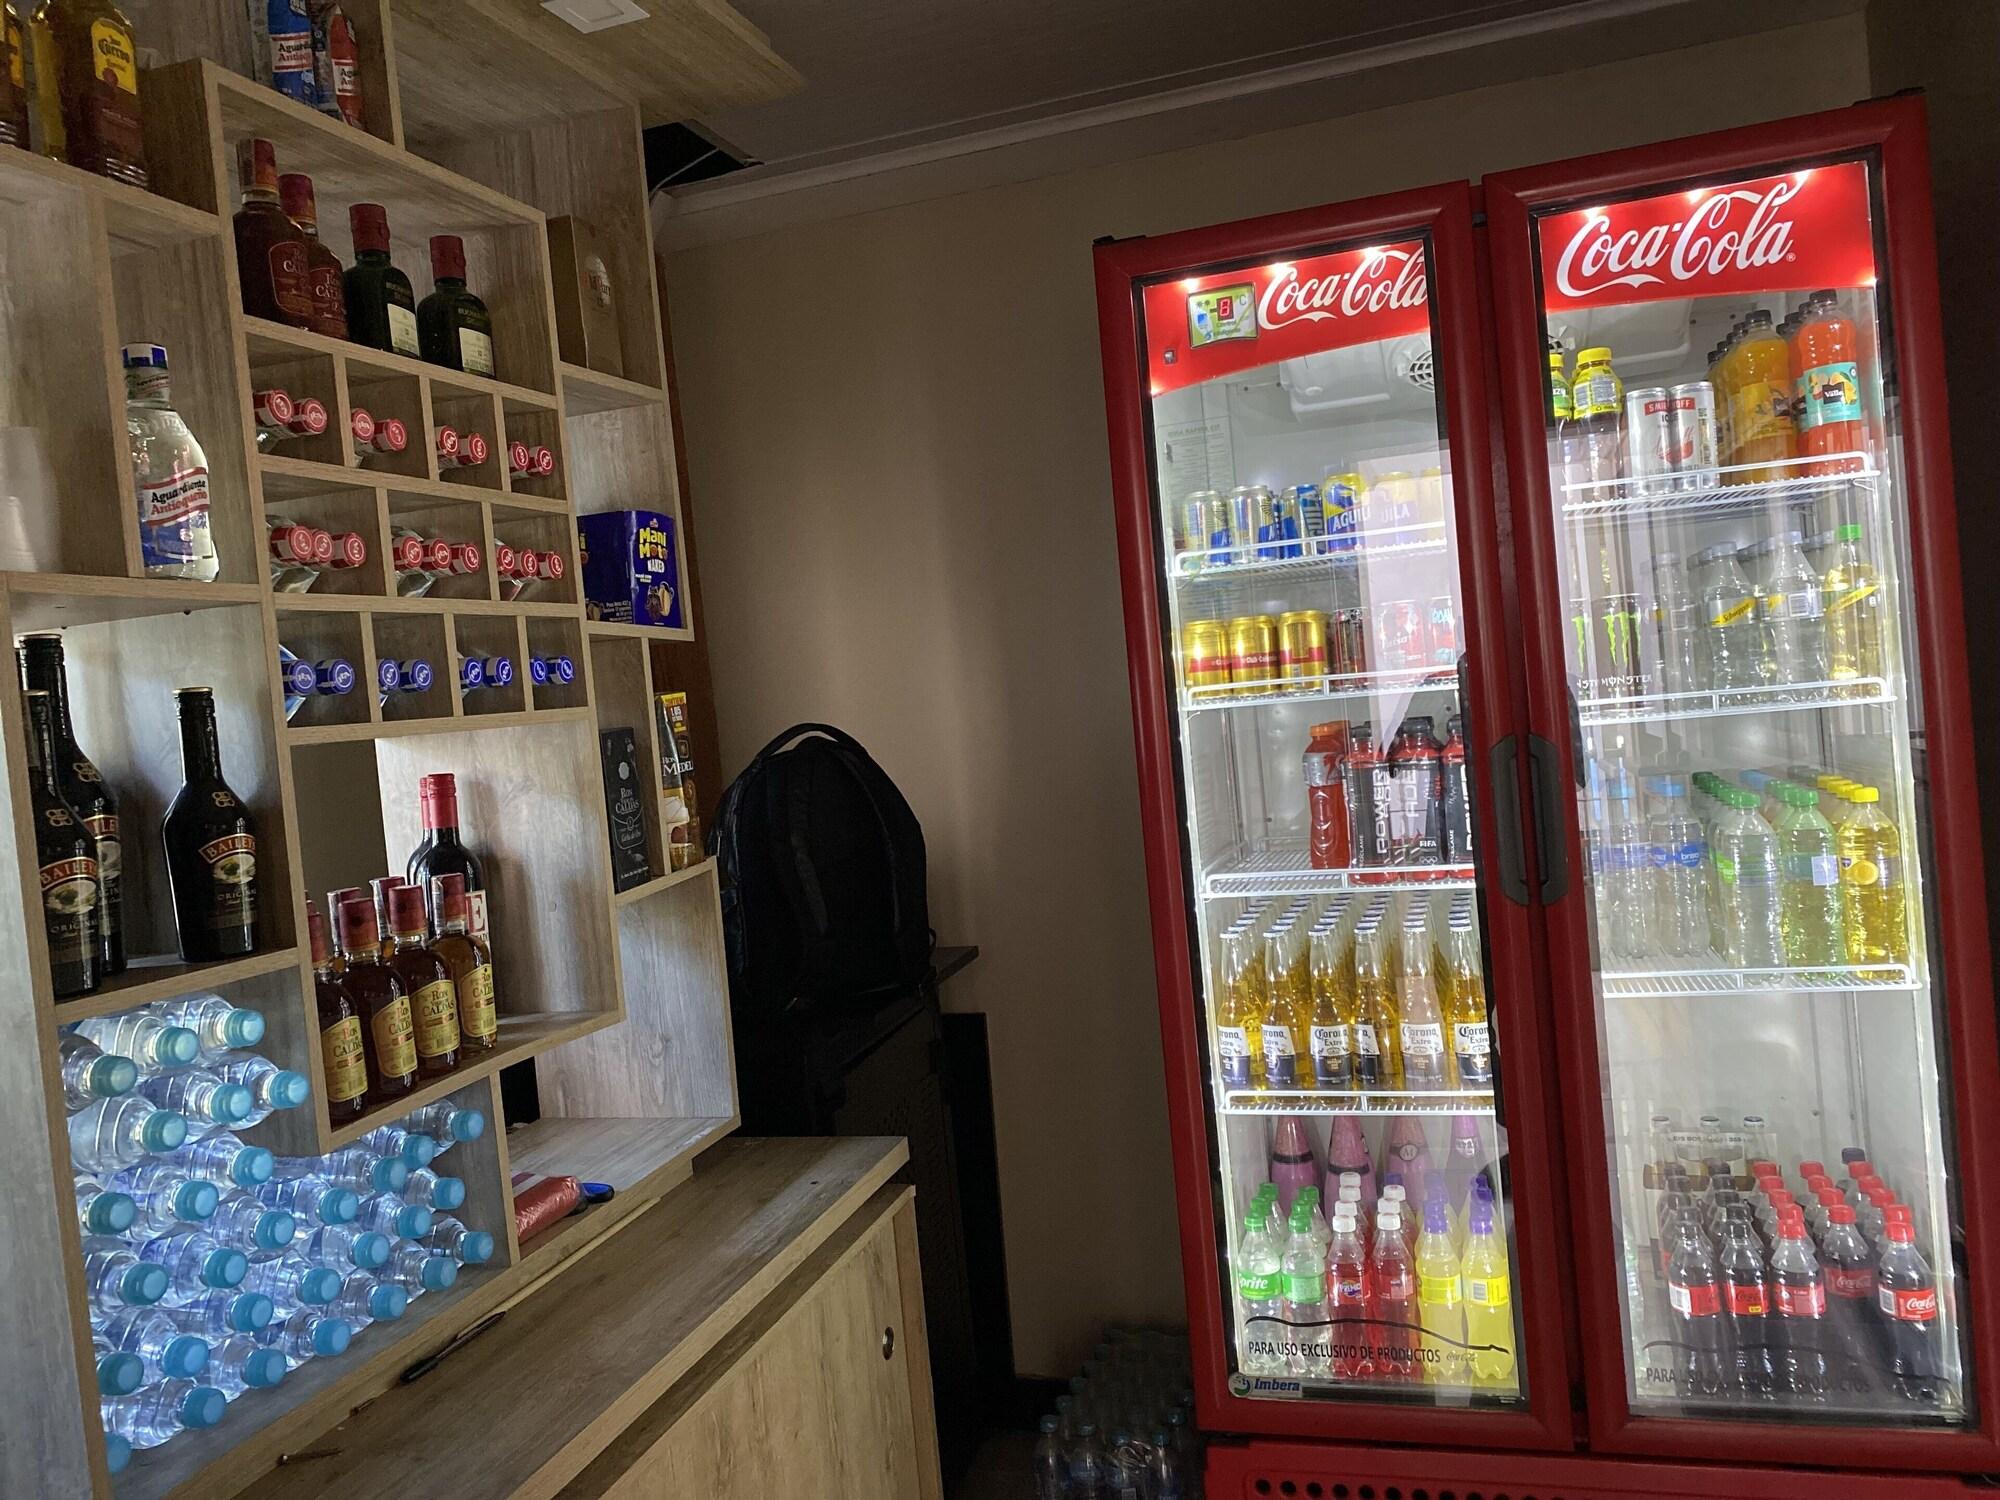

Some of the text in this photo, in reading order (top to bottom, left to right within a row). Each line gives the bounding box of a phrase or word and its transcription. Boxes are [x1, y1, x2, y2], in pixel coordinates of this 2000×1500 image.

[1556, 177, 1801, 297] Coca-Cola
[1256, 246, 1428, 331] Coca-Cola
[1372, 768, 1387, 854] POWER
[1419, 840, 1437, 848] FIFA
[1248, 1341, 1275, 1356] PARA
[1277, 1342, 1298, 1357] USO
[1301, 1343, 1358, 1360] EXCLUSIVO
[1360, 1345, 1375, 1360] DE
[1377, 1346, 1441, 1363] PRODUCTOS
[1254, 1378, 1300, 1392] Imbera
[1646, 1366, 1676, 1383] PARA
